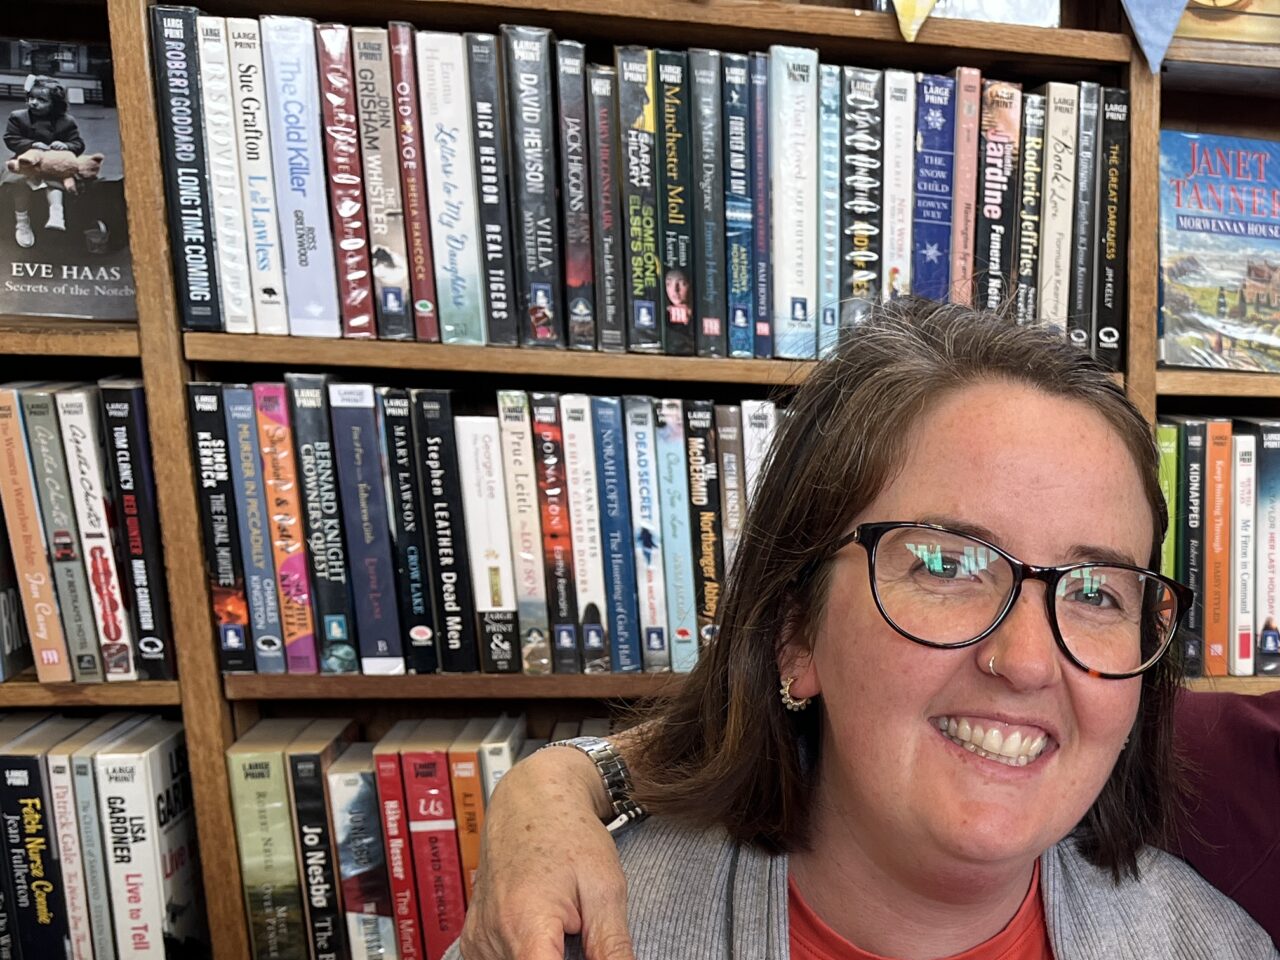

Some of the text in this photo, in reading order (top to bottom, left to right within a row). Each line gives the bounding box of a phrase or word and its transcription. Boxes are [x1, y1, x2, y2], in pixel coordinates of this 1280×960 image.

[238, 64, 263, 161] Sue Grafton
[280, 60, 310, 196] The Cold Killer
[358, 68, 380, 150] GRISHAM
[377, 96, 391, 128] JOHN
[396, 82, 411, 117] OLD
[519, 73, 544, 194] DAVID HEWSON
[163, 41, 210, 302] ROBERT GODDARD LONG TIME COMING
[628, 130, 640, 188] HILARY
[637, 132, 653, 187] SARAH
[664, 85, 685, 225] Manchester Moll
[917, 182, 949, 193] CHILD
[919, 167, 947, 179] SNOW
[924, 155, 945, 166] THE
[983, 130, 1009, 220] Jardine
[1185, 140, 1270, 183] JANET
[367, 155, 387, 235] WHISTLER
[385, 188, 395, 210] THE
[476, 101, 508, 320] MICK HERRON REAL TIGERS
[1019, 136, 1043, 277] Roderic Jeffries
[1179, 216, 1247, 236] MORWENNAN
[5, 281, 48, 293] Secrets
[53, 284, 68, 295] of
[70, 285, 90, 296] the
[11, 262, 121, 280] EVE HAAS
[113, 427, 134, 490] TOM CLANCY
[394, 425, 416, 533] MARY LAWSON
[635, 431, 651, 521] DEAD SECRET
[688, 437, 708, 506] McDERMID
[315, 442, 345, 584] BERNARD KNIGHT
[1188, 464, 1200, 528] KIDNAPPED
[426, 437, 462, 650] Stephen LEATHER Dead Men
[107, 796, 132, 864] GARDNER
[128, 816, 146, 844] LISA
[124, 874, 150, 951] Live to Tell
[302, 825, 322, 846] Jo
[314, 917, 332, 949] The
